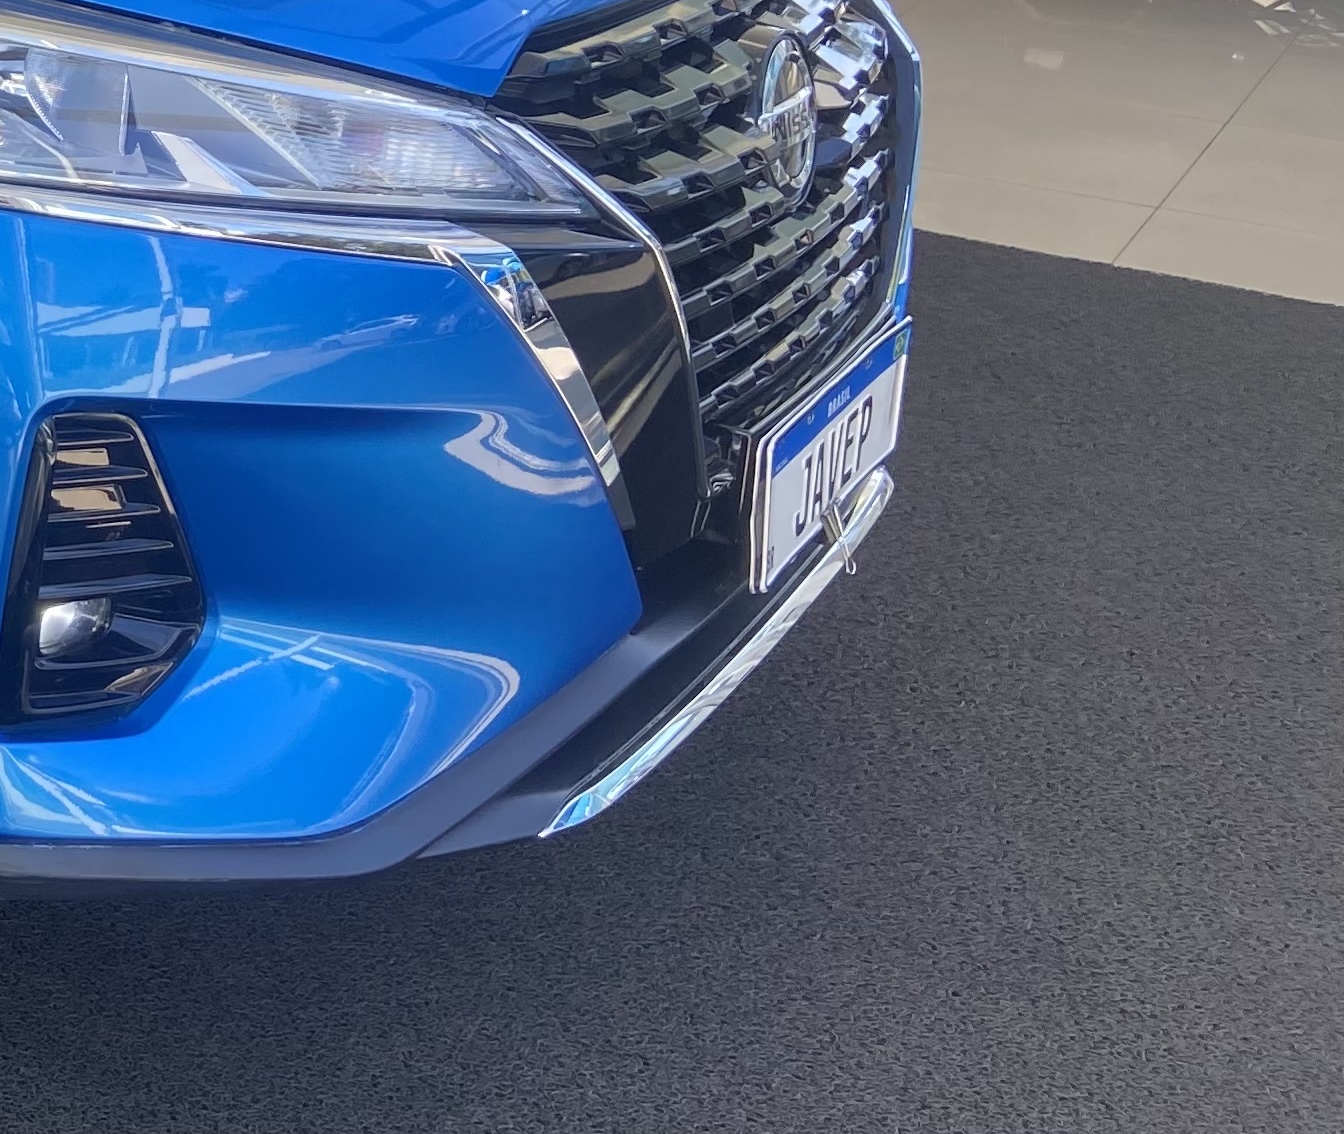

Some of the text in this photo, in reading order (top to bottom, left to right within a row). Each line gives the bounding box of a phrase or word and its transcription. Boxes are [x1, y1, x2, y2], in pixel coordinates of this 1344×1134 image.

[770, 103, 815, 147] NISS
[827, 385, 852, 418] BRASIL
[792, 393, 874, 538] JAVEP
